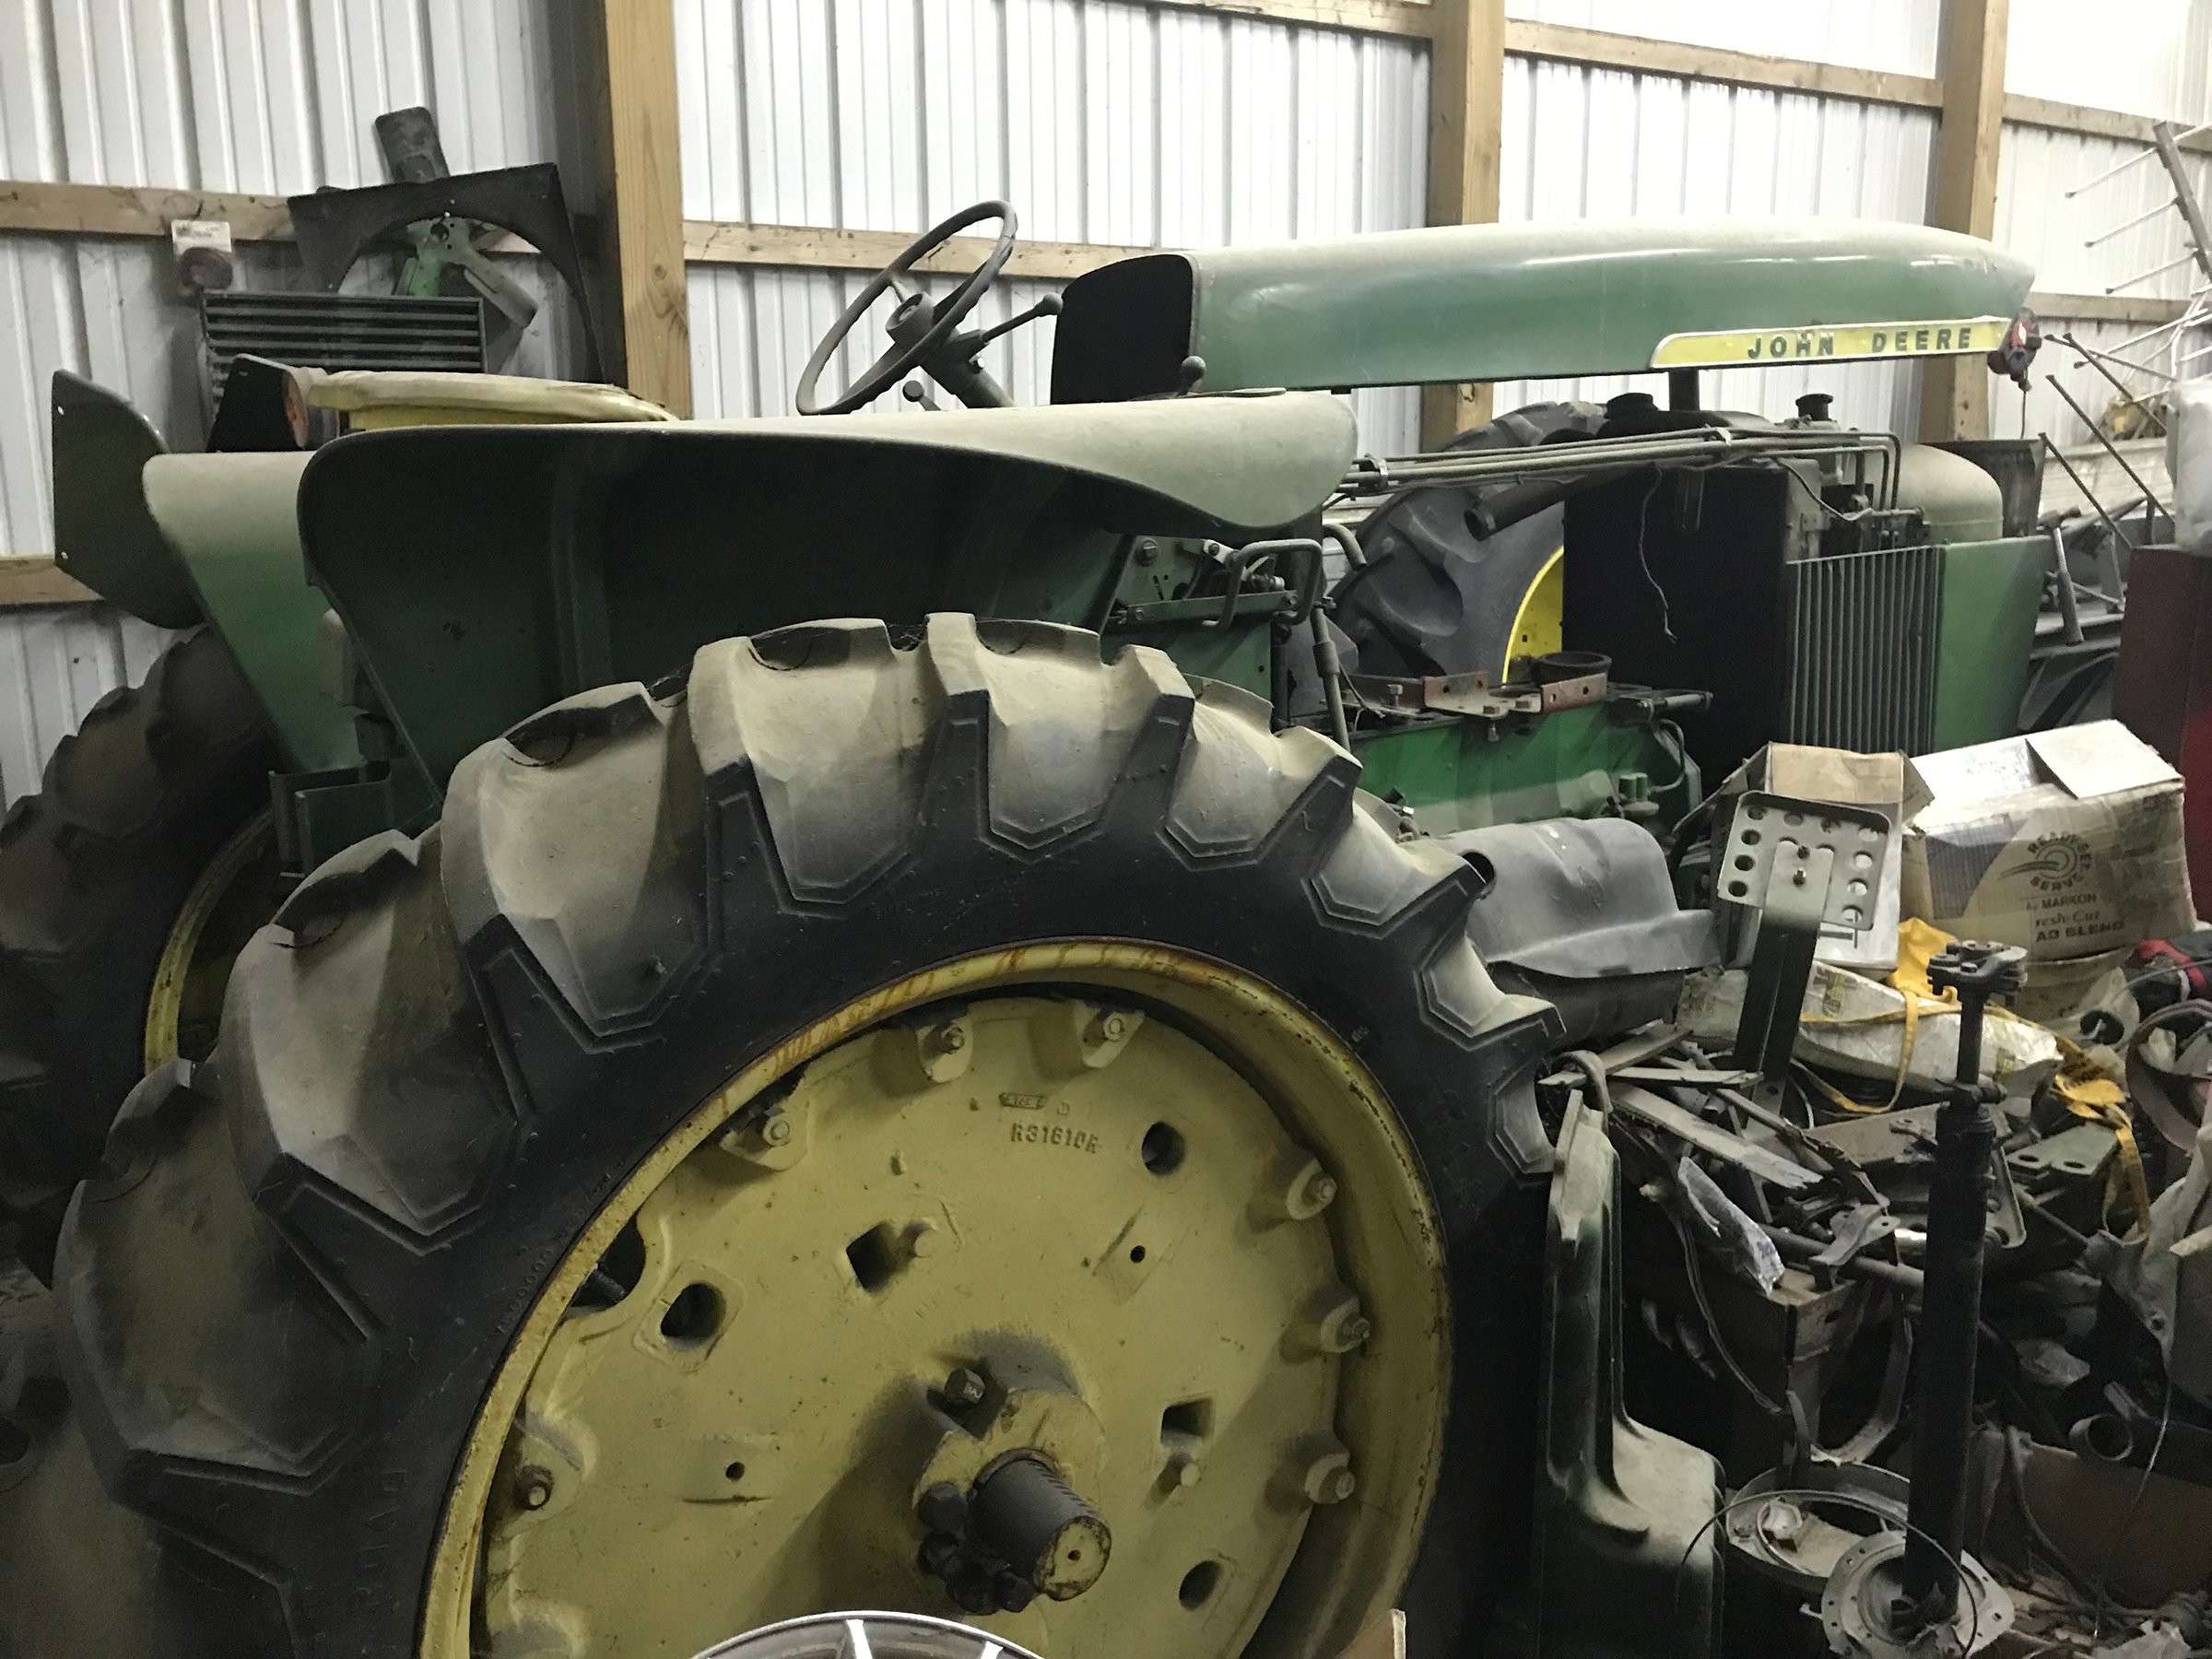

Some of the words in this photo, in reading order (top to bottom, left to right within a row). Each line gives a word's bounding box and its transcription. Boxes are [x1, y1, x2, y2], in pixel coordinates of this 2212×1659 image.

[1747, 331, 1834, 360] JOHN
[1872, 327, 1972, 354] DEERE
[2041, 893, 2099, 909] MARKON
